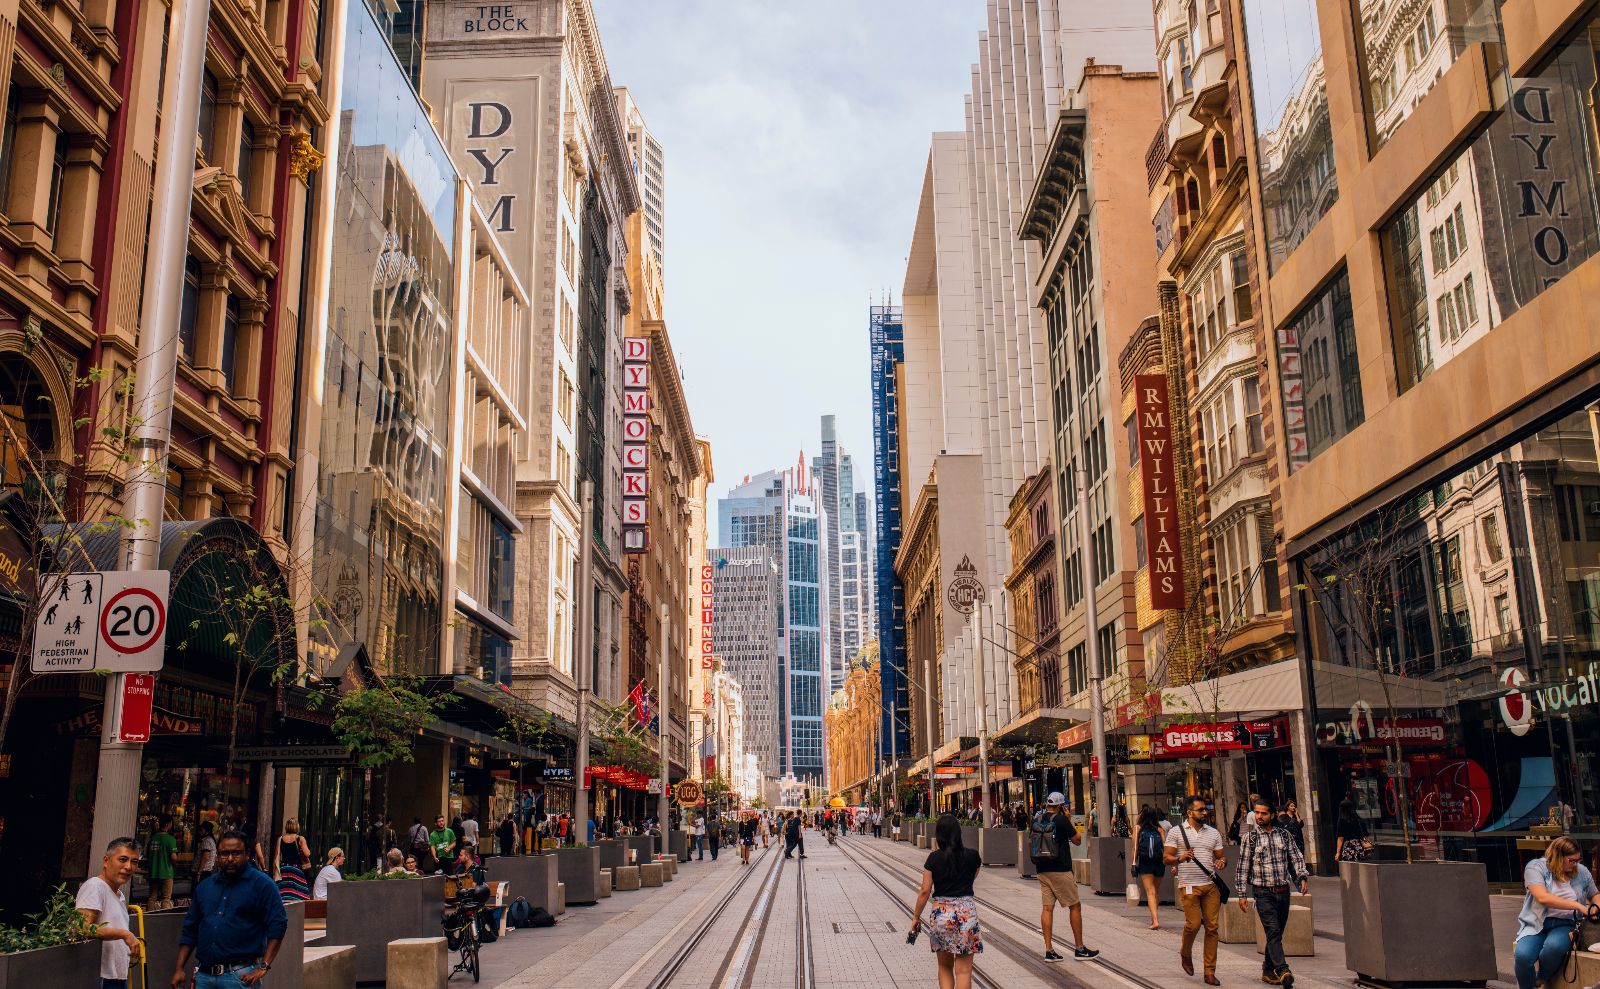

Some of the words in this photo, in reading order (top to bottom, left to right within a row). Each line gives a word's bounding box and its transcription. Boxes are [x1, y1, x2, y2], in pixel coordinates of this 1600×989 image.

[477, 6, 514, 19] THE
[465, 18, 528, 33] BLOCK
[625, 340, 645, 522] DYMOCKS
[957, 588, 976, 603] HCF
[110, 605, 155, 636] 20
[702, 567, 712, 669] GOWINGS
[55, 639, 76, 647] HIGH
[40, 648, 89, 657] PEDESTRIAN
[45, 658, 82, 666] ACTIVITY
[135, 678, 144, 686] NO
[127, 686, 150, 696] STOPPING
[55, 709, 98, 735] THE
[543, 768, 571, 776] HYPE
[680, 786, 697, 798] UGG
